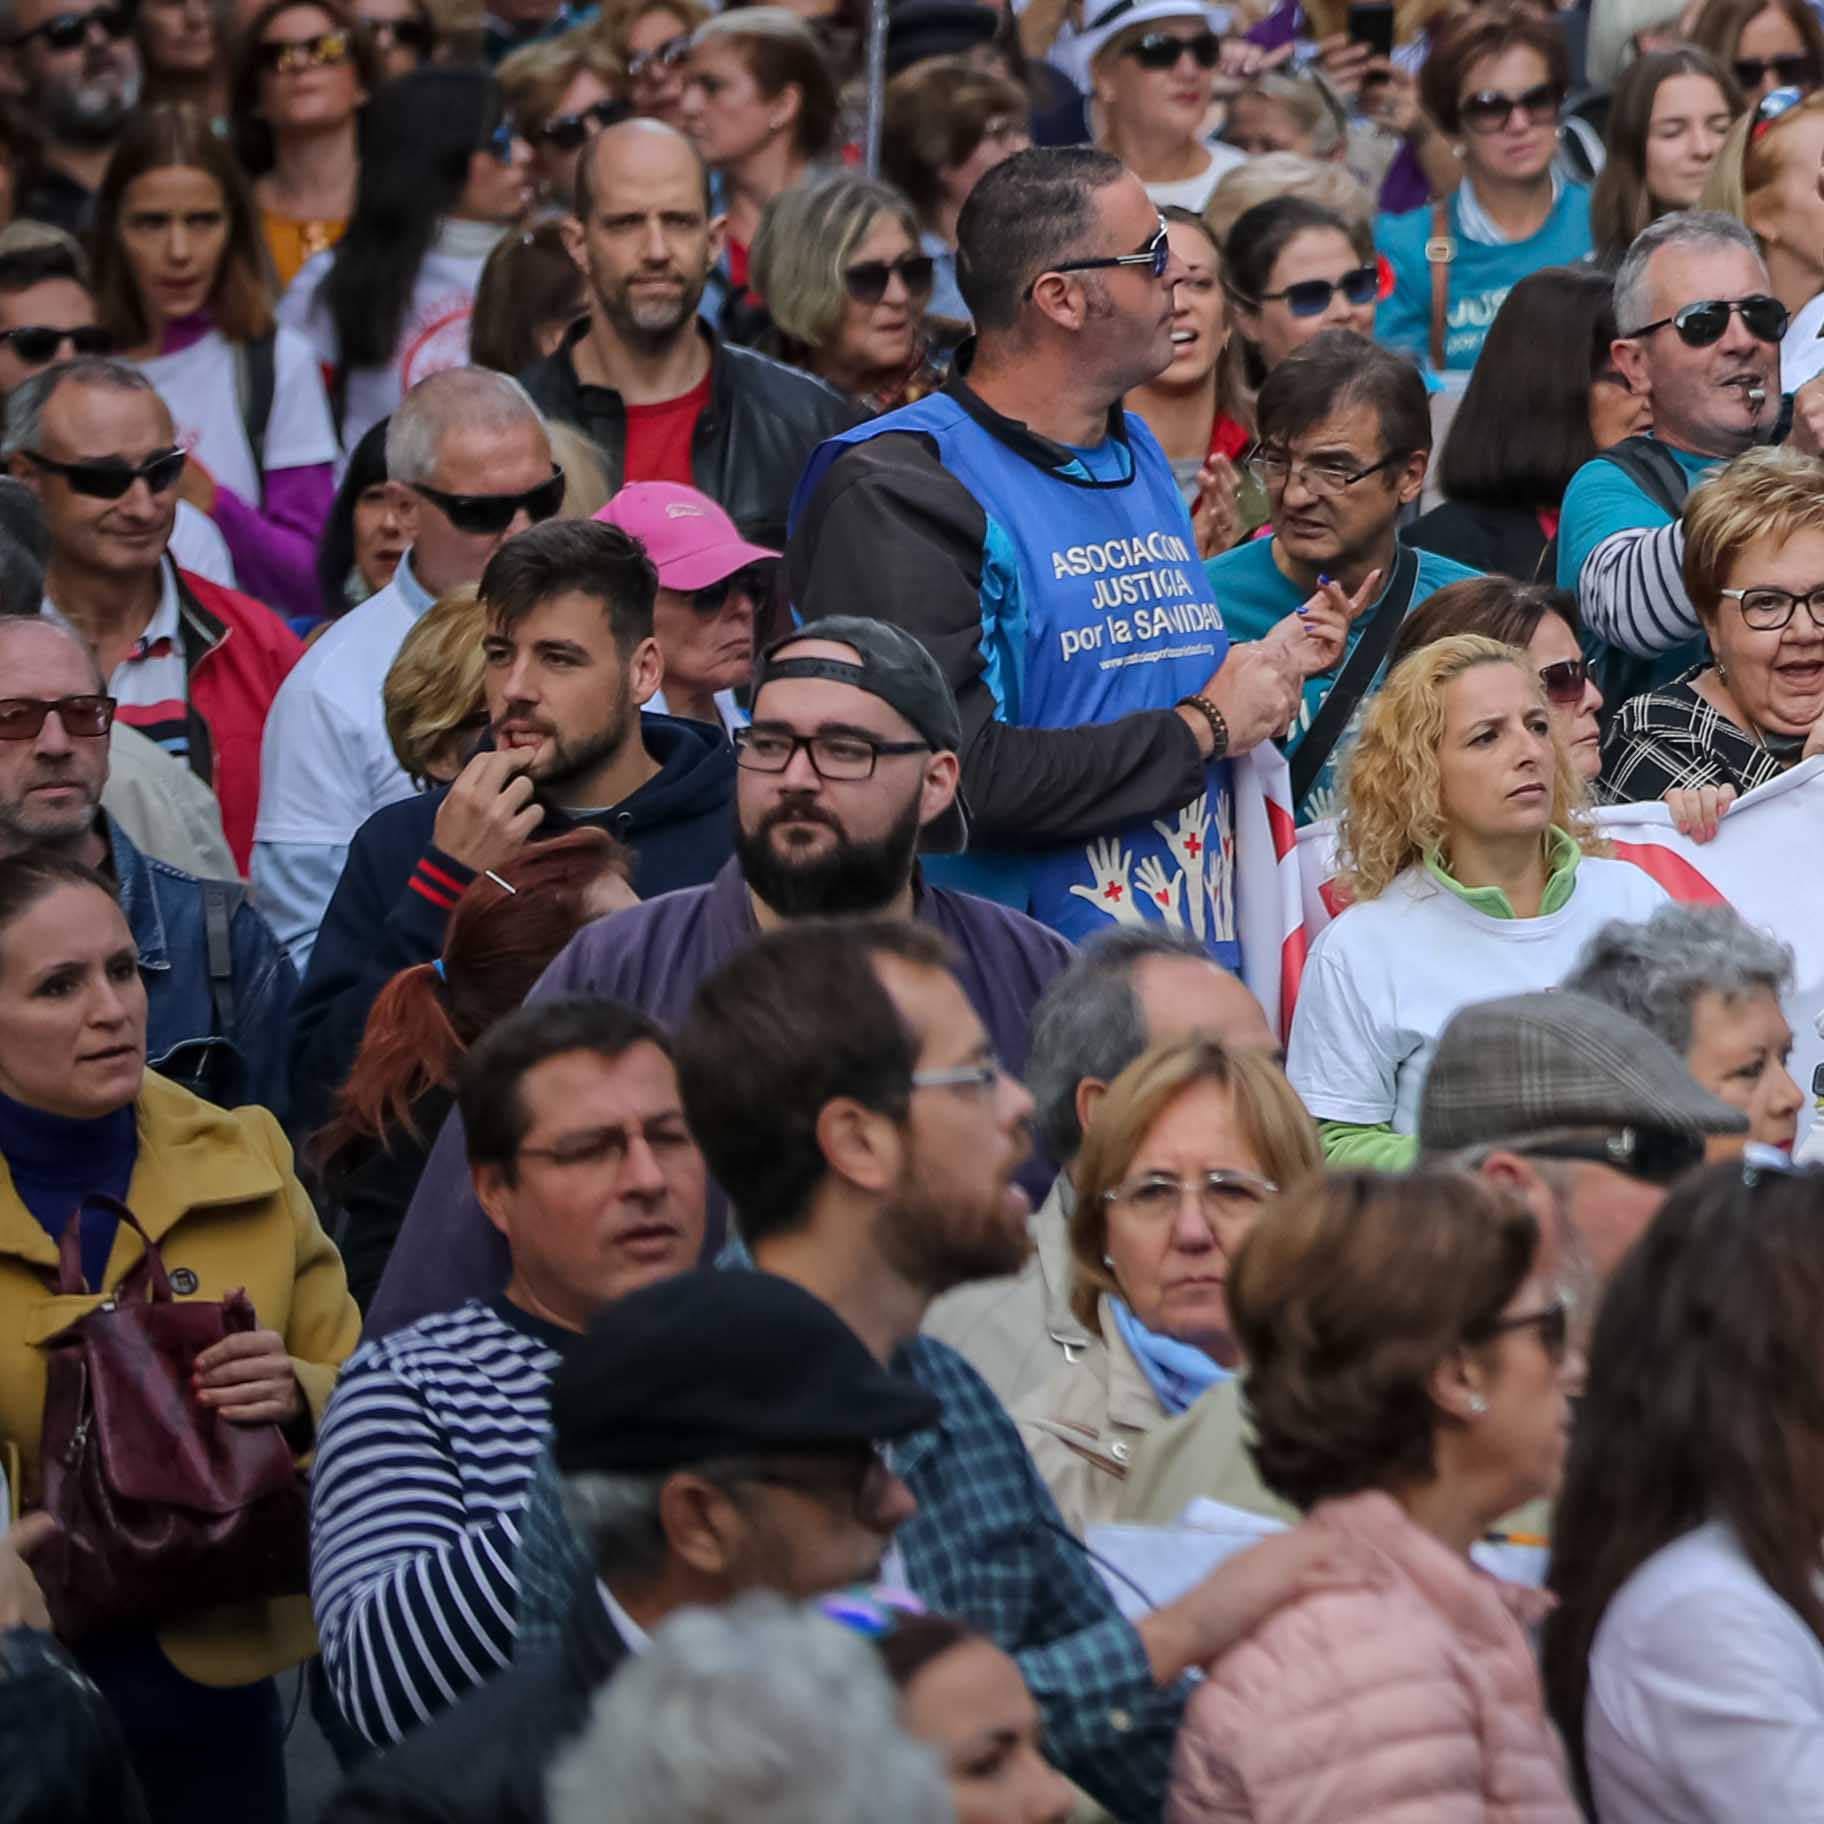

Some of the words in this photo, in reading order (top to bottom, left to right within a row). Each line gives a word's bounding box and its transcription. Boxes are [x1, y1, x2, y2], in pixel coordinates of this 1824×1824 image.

[1091, 567, 1193, 610] JUSTICIA
[1060, 623, 1104, 662] por
[1106, 615, 1134, 645] la
[1134, 602, 1225, 641] SANIDAD
